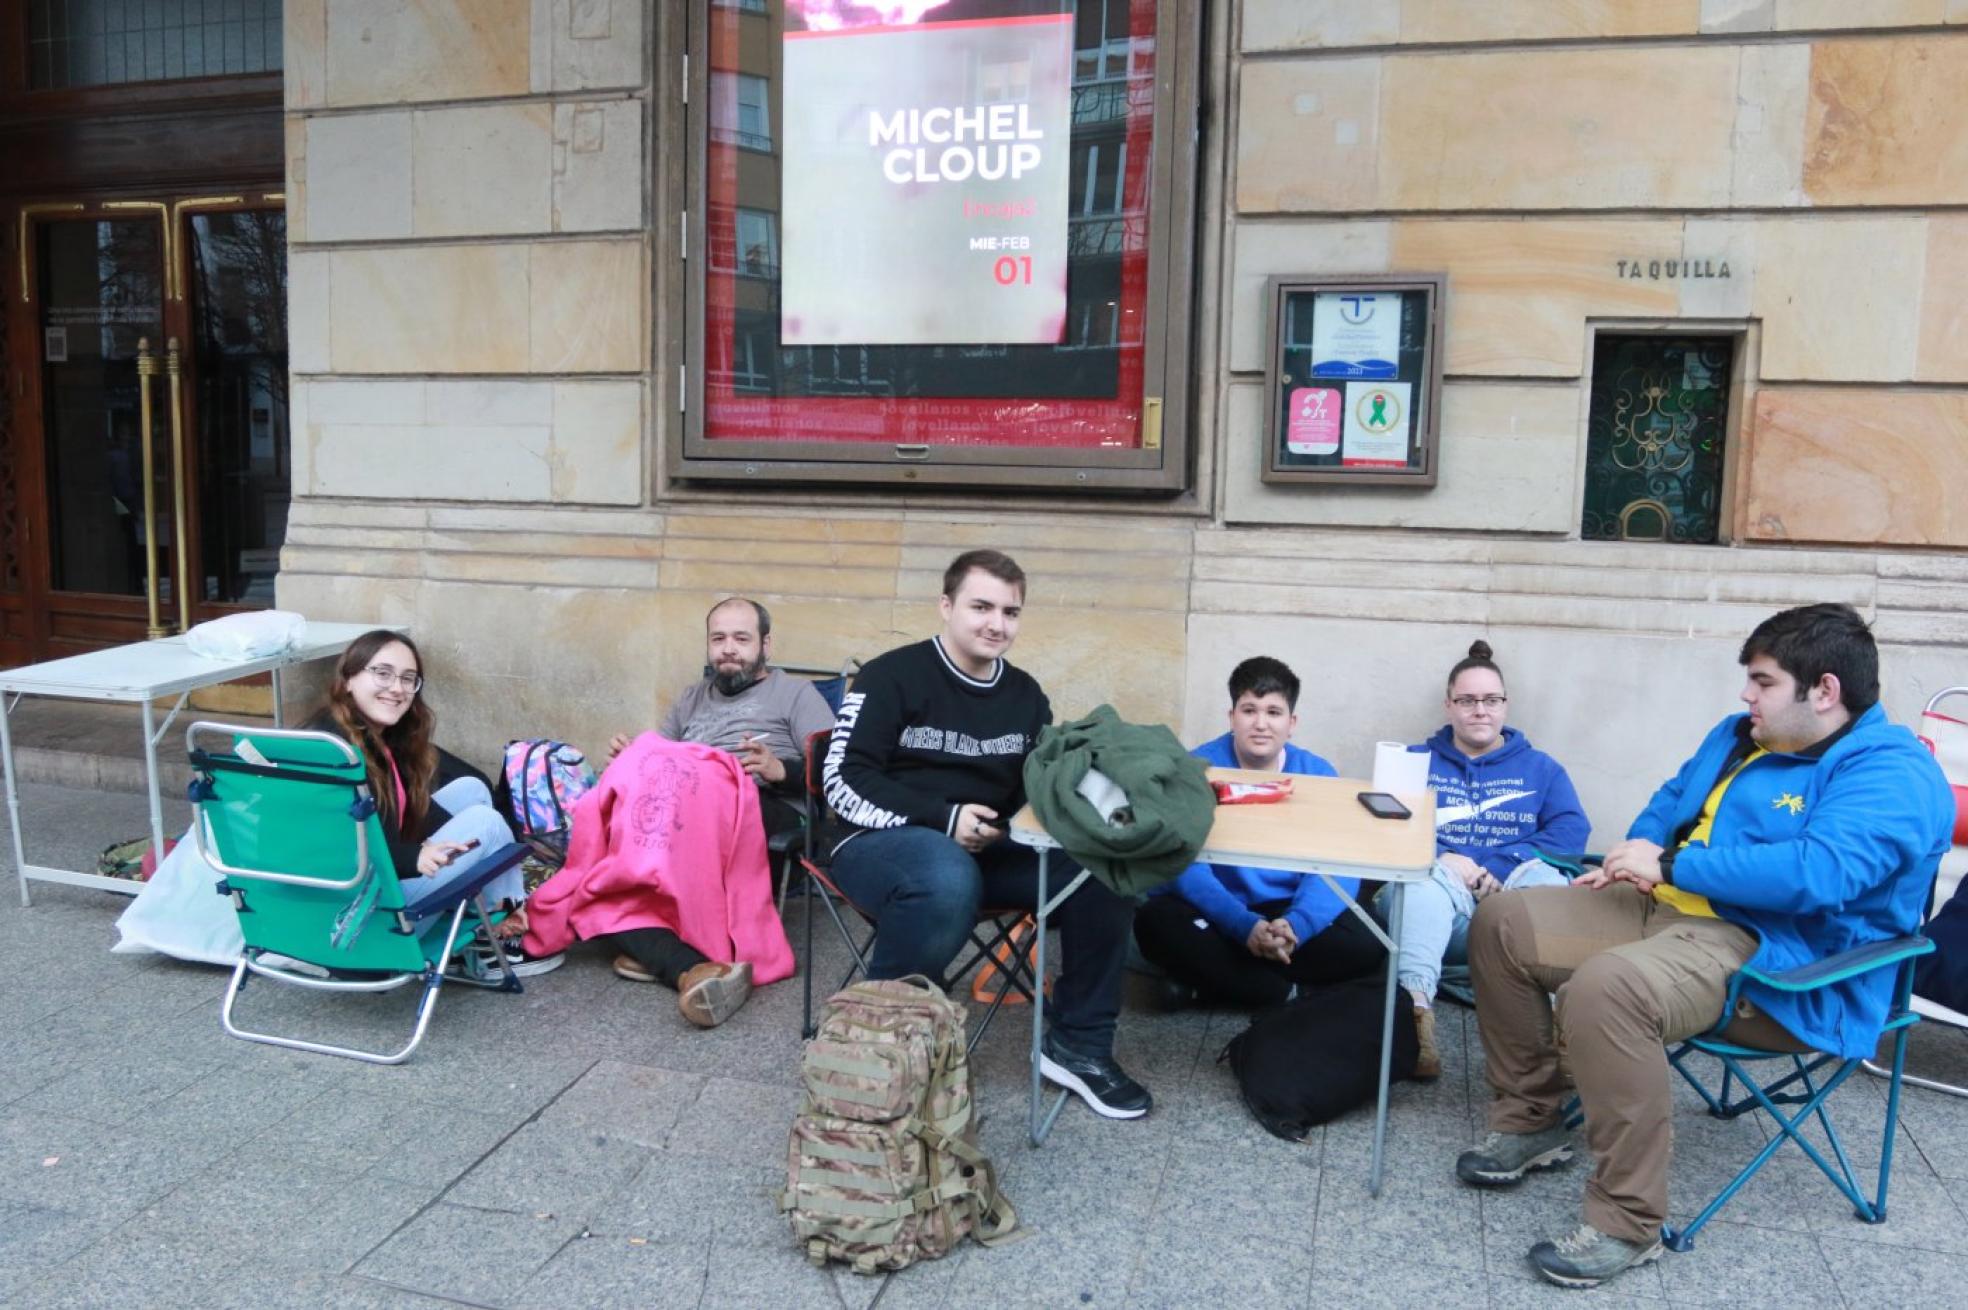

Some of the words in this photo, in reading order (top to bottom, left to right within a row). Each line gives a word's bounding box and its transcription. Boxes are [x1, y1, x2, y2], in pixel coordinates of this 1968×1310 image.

[869, 104, 1044, 146] MICHEL
[883, 144, 1041, 184] CLOUP
[969, 236, 1030, 251] MIE-FEB
[993, 255, 1034, 286] 01
[1617, 260, 1731, 280] TAQUILLA
[880, 402, 970, 416] jovellanos
[1485, 811, 1517, 822] 97005
[1474, 823, 1489, 834] for
[1490, 825, 1520, 836] sport
